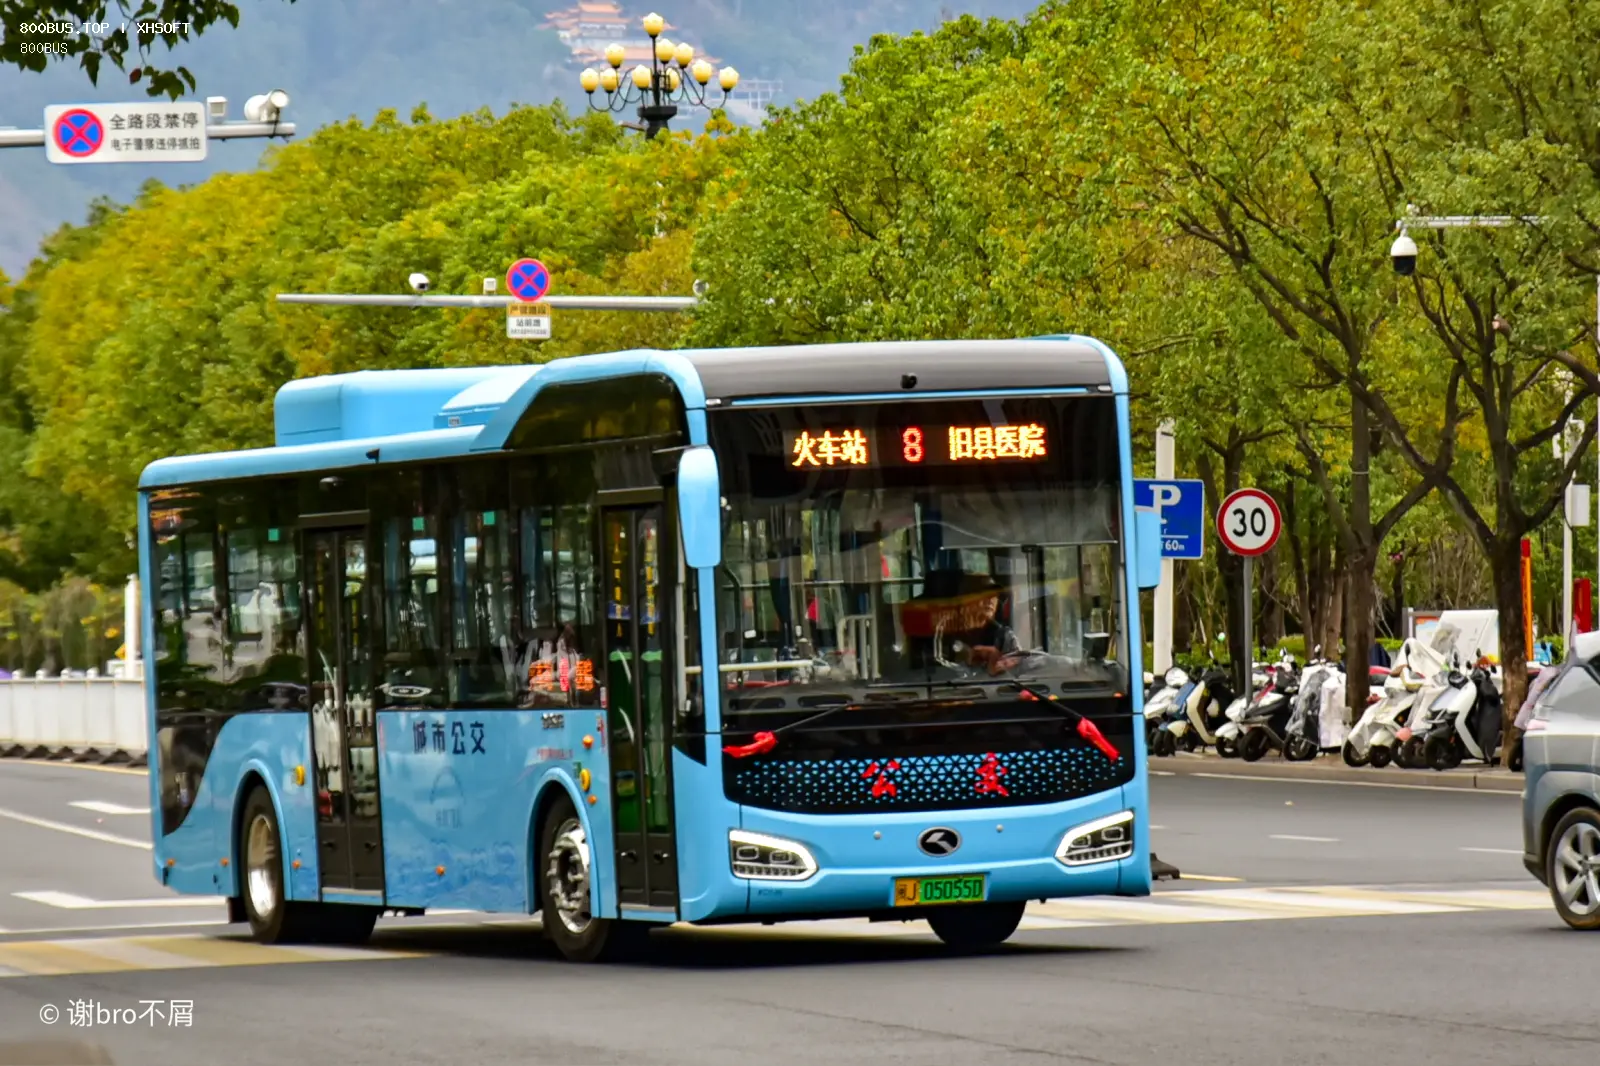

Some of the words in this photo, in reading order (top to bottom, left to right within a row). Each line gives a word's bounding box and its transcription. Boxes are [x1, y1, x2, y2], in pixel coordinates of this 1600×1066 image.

[109, 112, 199, 130] 全路段禁停
[792, 430, 867, 466] 火车站
[903, 427, 922, 462] 8
[948, 424, 1047, 460] 旧县医院
[1149, 484, 1182, 514] P
[1232, 507, 1267, 538] 30
[413, 720, 486, 755] 城市公交
